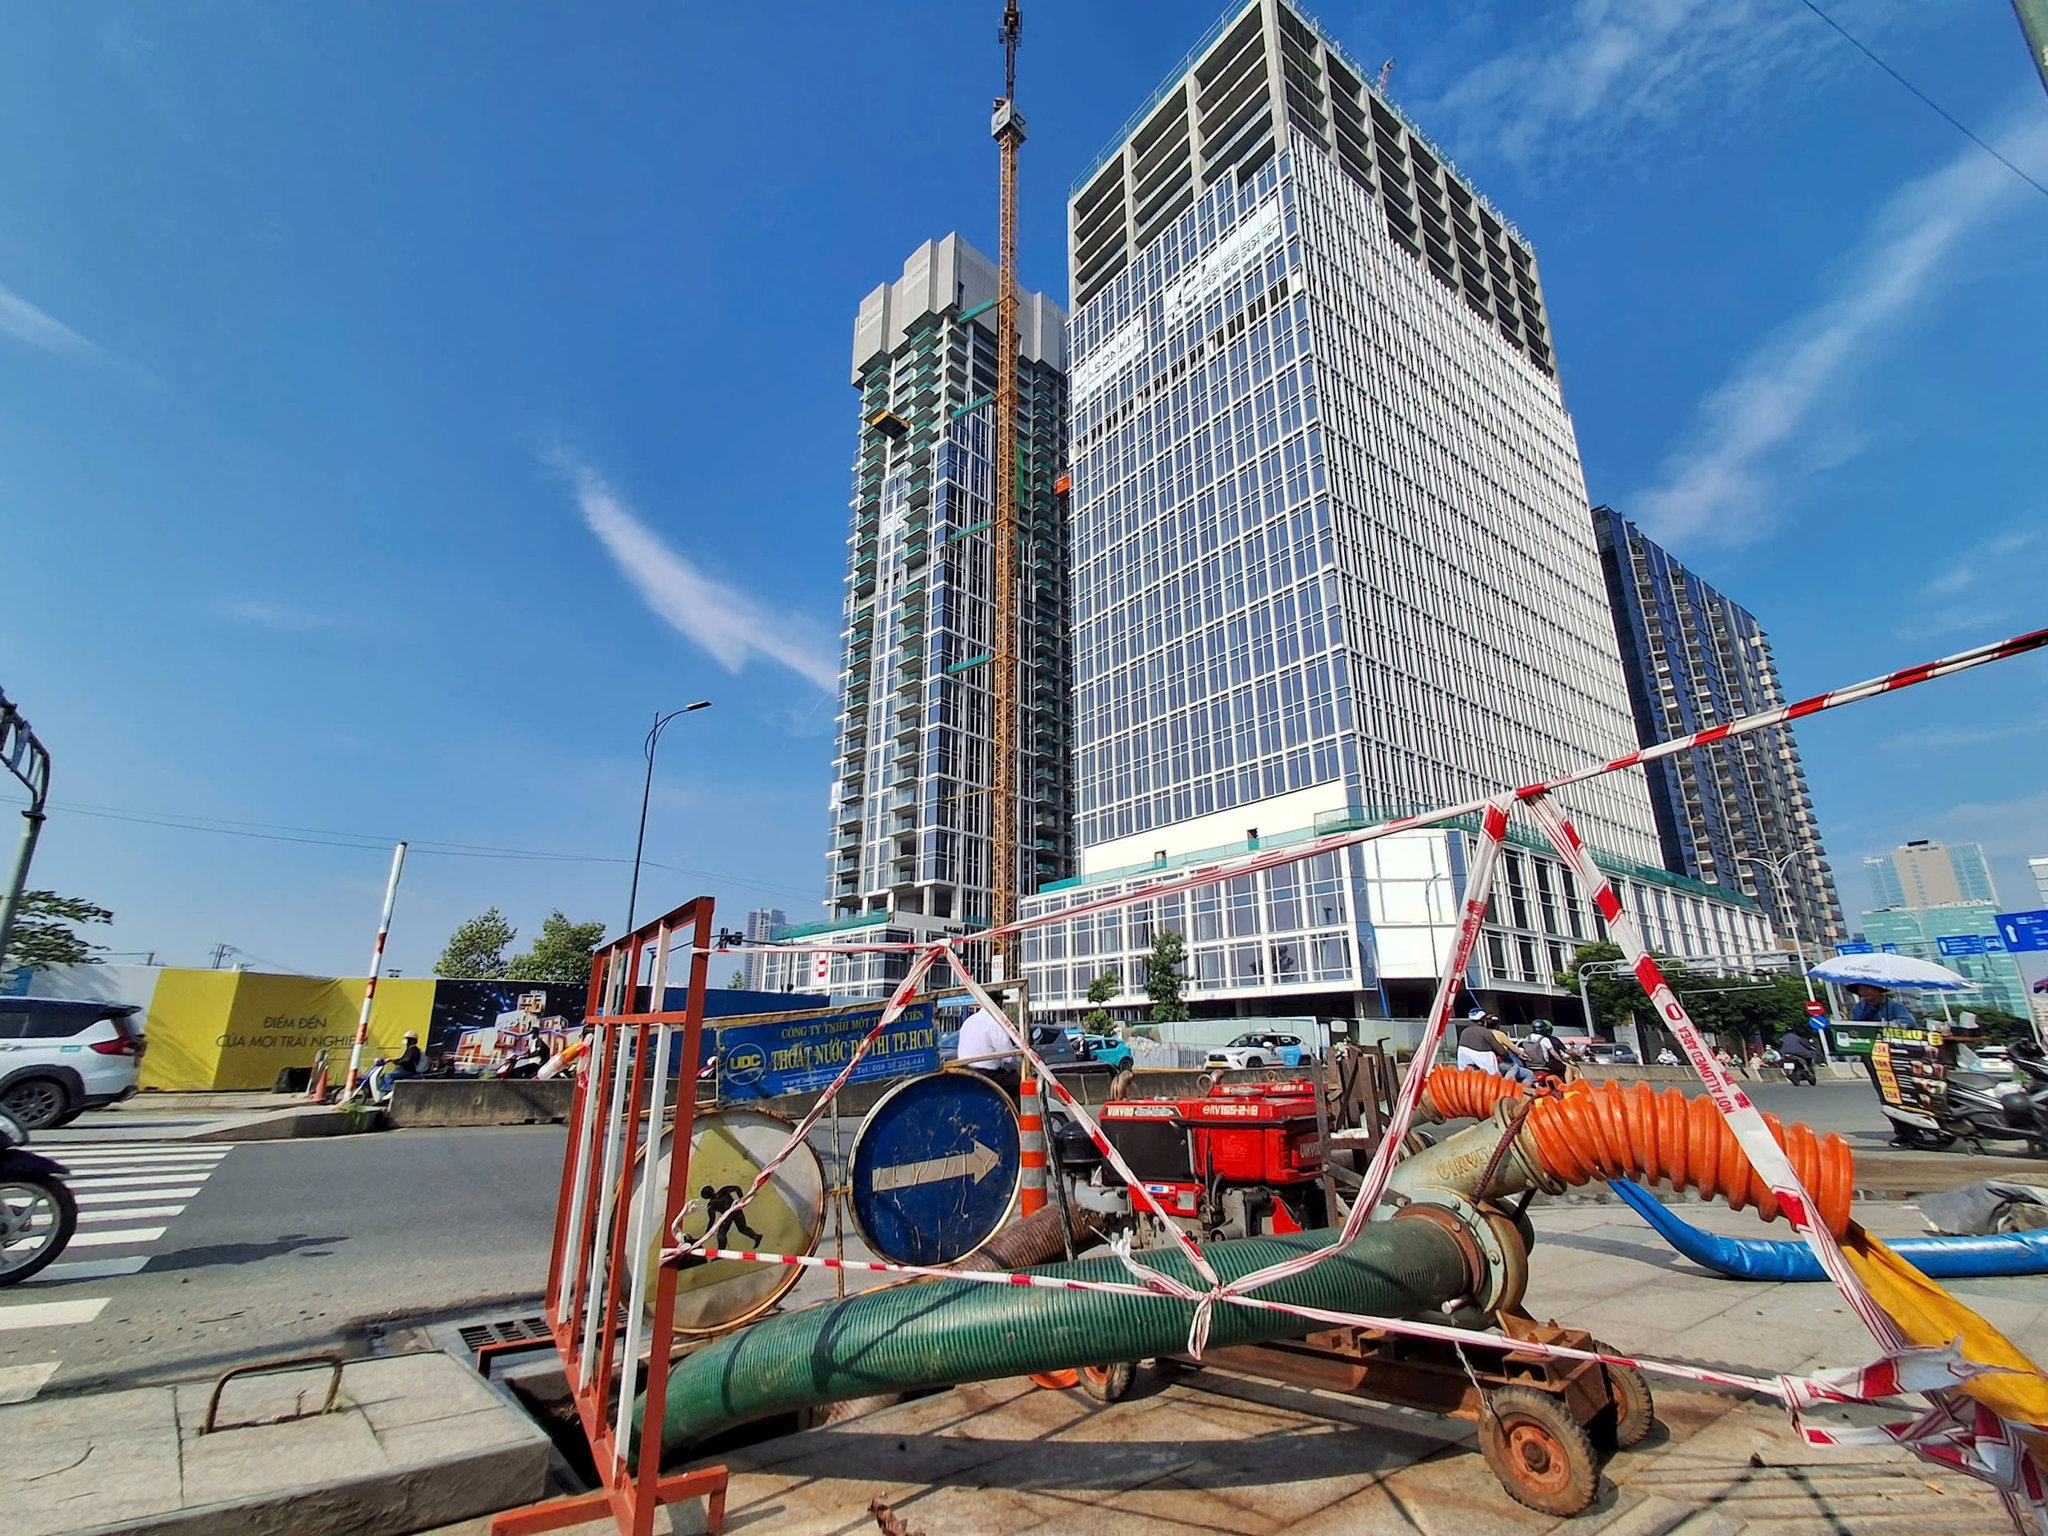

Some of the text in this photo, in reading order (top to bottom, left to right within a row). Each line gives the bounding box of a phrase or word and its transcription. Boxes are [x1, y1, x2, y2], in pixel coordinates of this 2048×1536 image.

[782, 1026, 807, 1038] CÔNG
[809, 1024, 821, 1035] TY
[824, 1020, 849, 1033] TNHH
[904, 1010, 924, 1021] VIÊN
[1882, 1027, 1923, 1040] MENU
[815, 1036, 848, 1065] NƯỚC
[871, 1035, 890, 1059] THỊ
[892, 1028, 934, 1053] TP.HCM
[729, 1054, 761, 1070] UDC
[1678, 1026, 1736, 1114] NOT ALLOWED AREA
